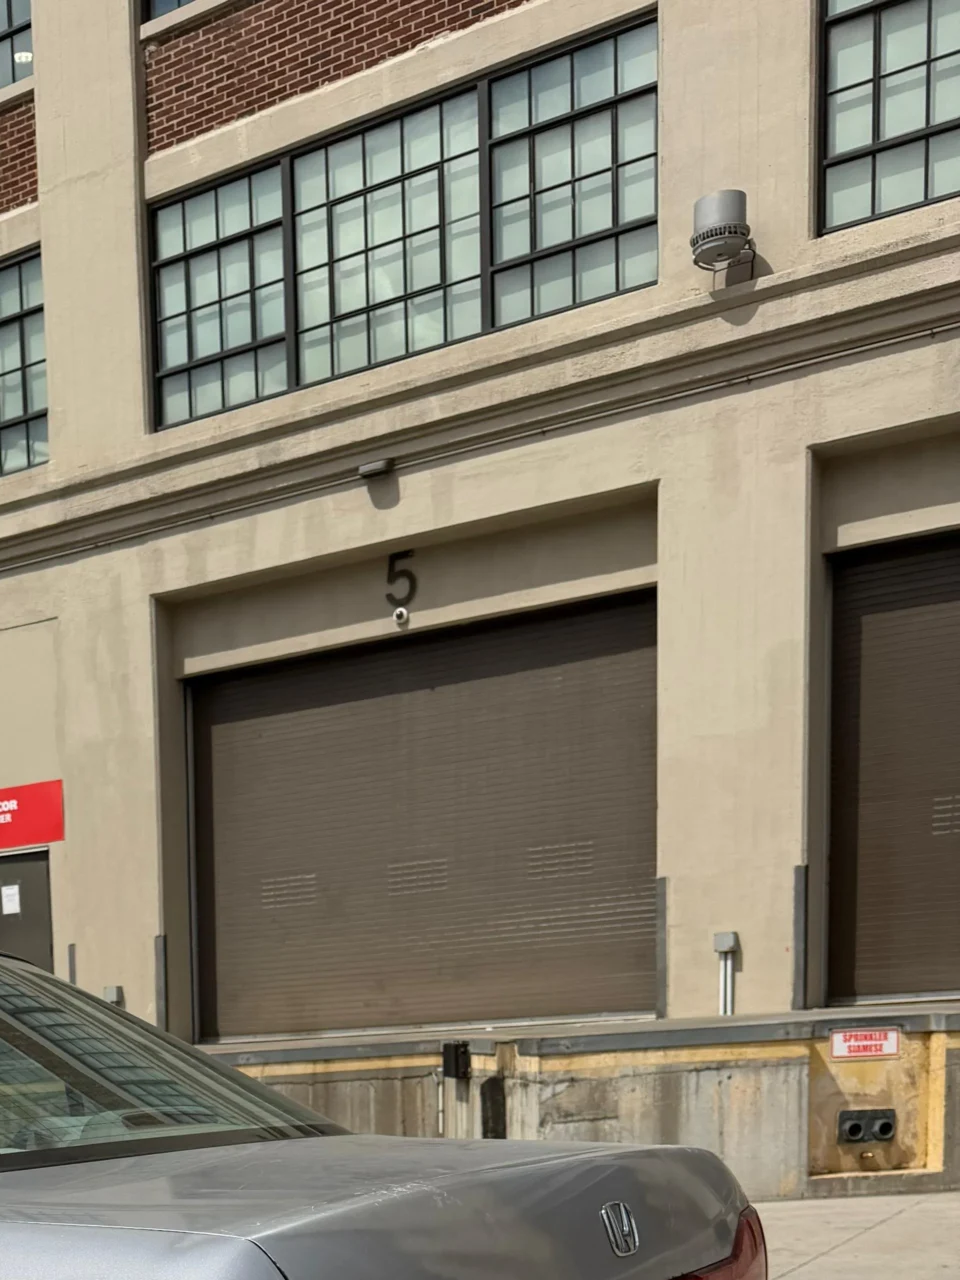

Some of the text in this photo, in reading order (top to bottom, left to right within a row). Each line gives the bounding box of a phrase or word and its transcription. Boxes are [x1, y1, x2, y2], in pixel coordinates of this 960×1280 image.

[385, 549, 417, 608] 5
[842, 1031, 888, 1043] SPRINKLER
[847, 1043, 883, 1054] SIAMESE
